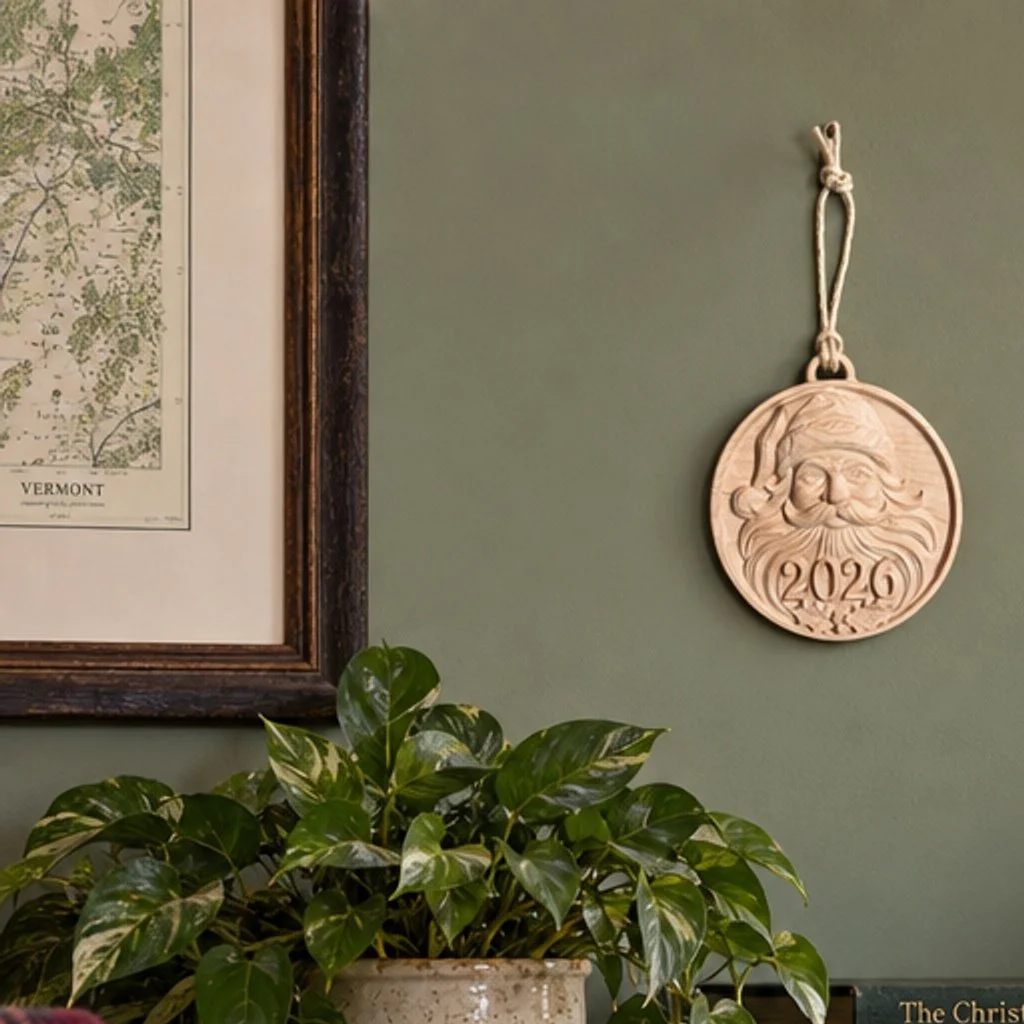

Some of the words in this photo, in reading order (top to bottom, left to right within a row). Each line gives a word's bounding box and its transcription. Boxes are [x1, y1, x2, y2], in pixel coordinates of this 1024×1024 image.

[20, 481, 105, 497] VERMONT
[780, 557, 894, 604] 2026
[899, 1001, 945, 1024] The
